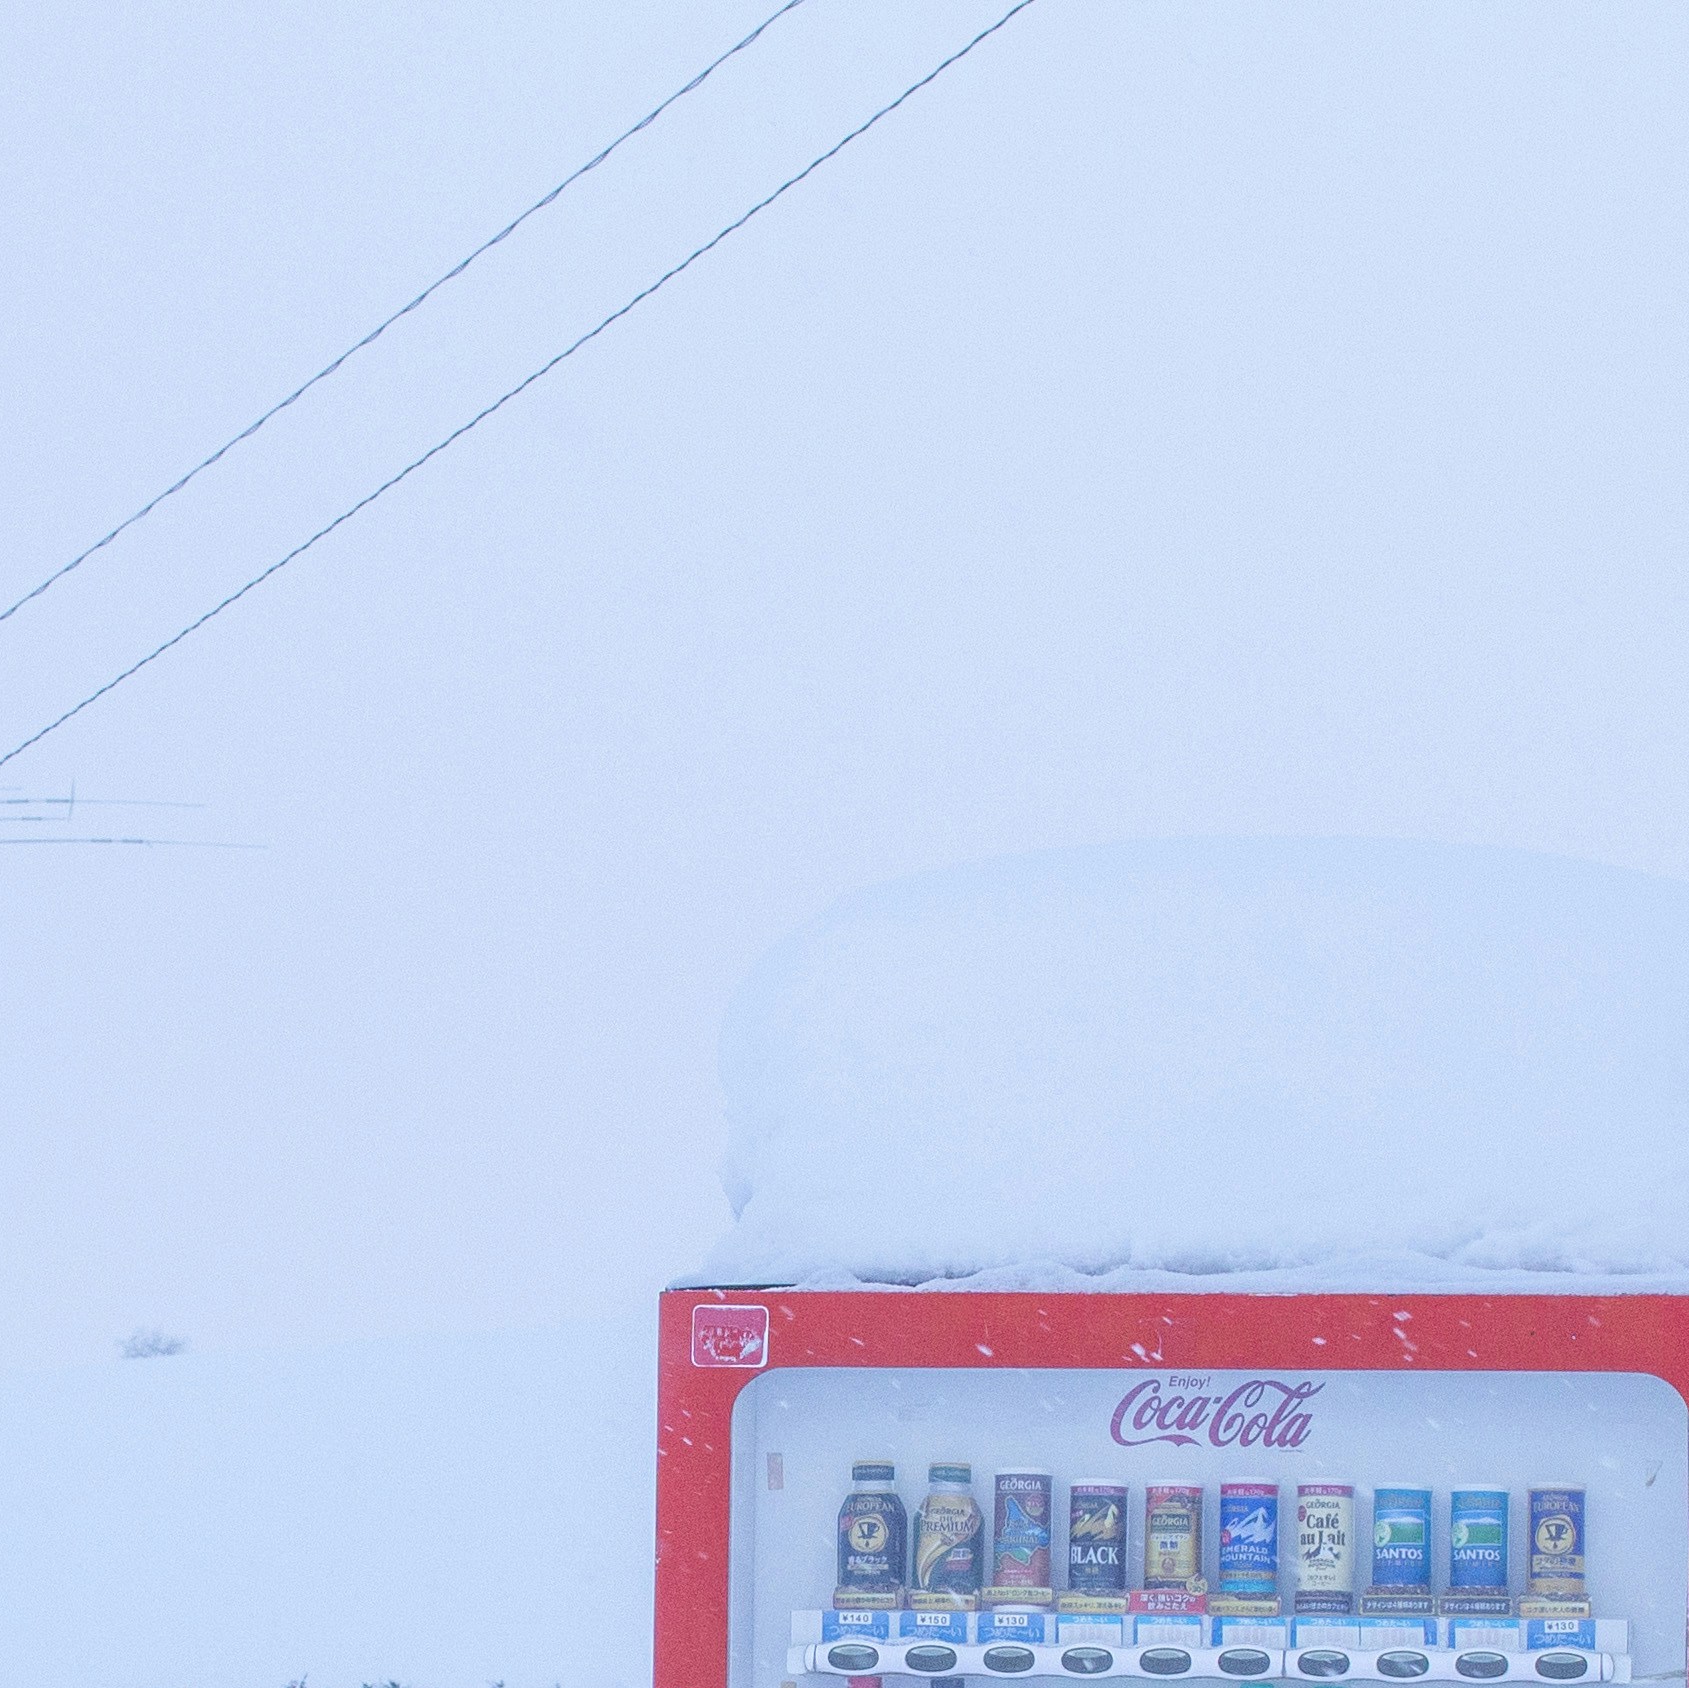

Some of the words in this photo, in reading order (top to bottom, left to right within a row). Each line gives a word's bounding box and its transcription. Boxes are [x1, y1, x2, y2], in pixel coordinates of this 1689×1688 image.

[1168, 1376, 1211, 1391] Enjoy!
[1110, 1379, 1325, 1448] Coca-Cola
[1000, 1479, 1042, 1490] GEORGIA
[1306, 1500, 1341, 1509] GEORGIA
[1533, 1502, 1579, 1512] EUROPEAN
[1152, 1515, 1188, 1526] GEORGIA
[1306, 1513, 1339, 1529] Café
[921, 1521, 974, 1533] PREMIUM
[1300, 1533, 1315, 1545] au
[1318, 1531, 1346, 1546] Lait
[1070, 1546, 1119, 1565] BLACK
[1222, 1545, 1269, 1555] EMERALD
[1376, 1548, 1423, 1560] SANTOS
[1453, 1549, 1500, 1561] SANTOS
[1221, 1554, 1270, 1564] MOUNTAIN
[842, 1614, 869, 1623] ¥140
[920, 1615, 947, 1624] ¥150
[997, 1616, 1024, 1626] ¥130
[1546, 1622, 1574, 1631] ¥130
